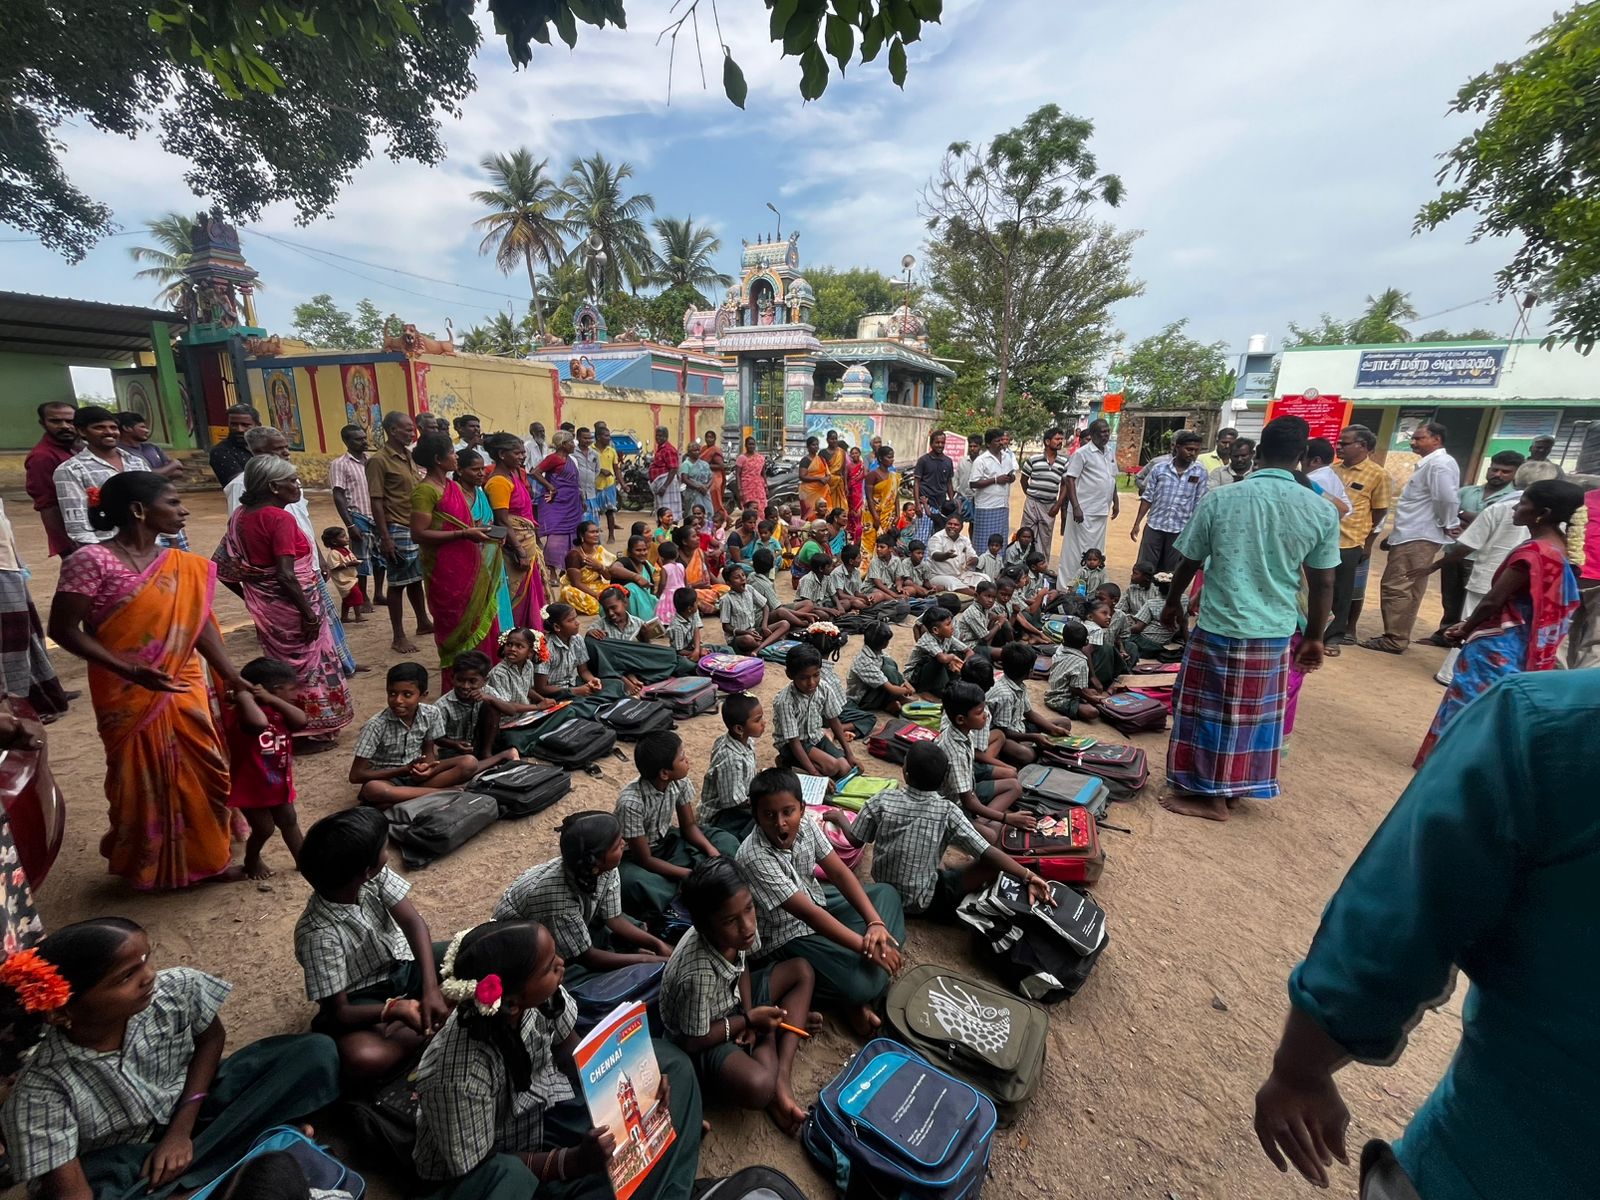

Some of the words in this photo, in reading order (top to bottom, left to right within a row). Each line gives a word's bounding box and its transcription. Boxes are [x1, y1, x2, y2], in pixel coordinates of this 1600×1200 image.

[1361, 357, 1400, 372] ஊராட்சி
[1400, 357, 1429, 371] மன்ற
[1431, 357, 1495, 371] அலுவலகம்
[590, 1048, 622, 1083] CHENNAI
